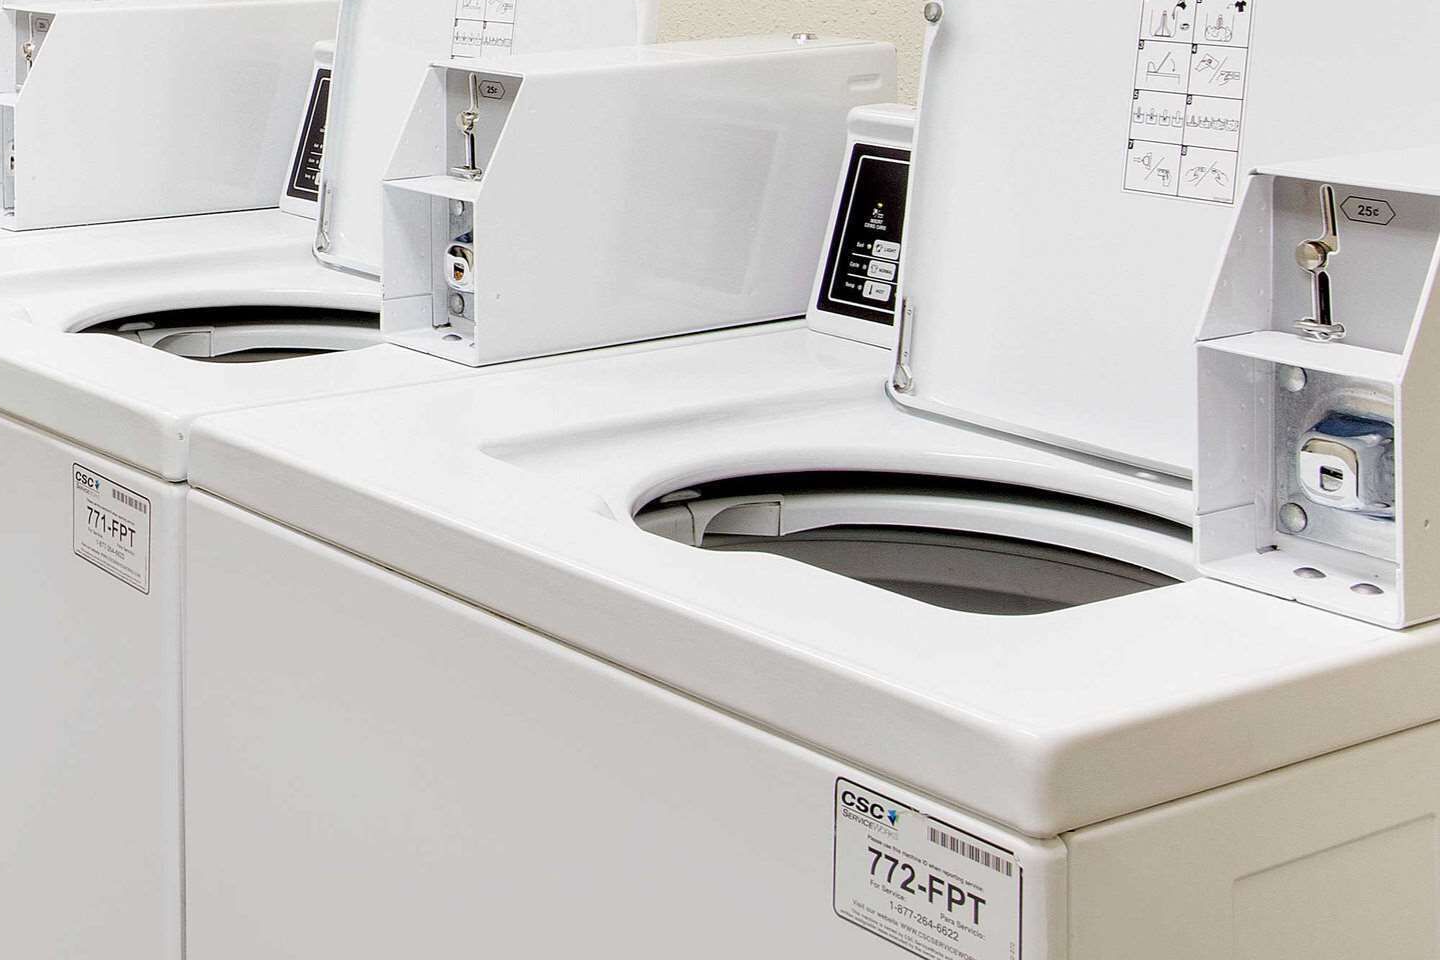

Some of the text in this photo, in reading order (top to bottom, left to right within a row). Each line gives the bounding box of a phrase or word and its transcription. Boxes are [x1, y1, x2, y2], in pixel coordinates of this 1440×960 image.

[75, 471, 94, 488] CSC
[87, 506, 136, 547] 771-FPT
[841, 790, 885, 820] CSC
[867, 846, 987, 925] 772-FPT
[869, 880, 880, 889] For
[889, 901, 959, 942] 1-877-264-6622
